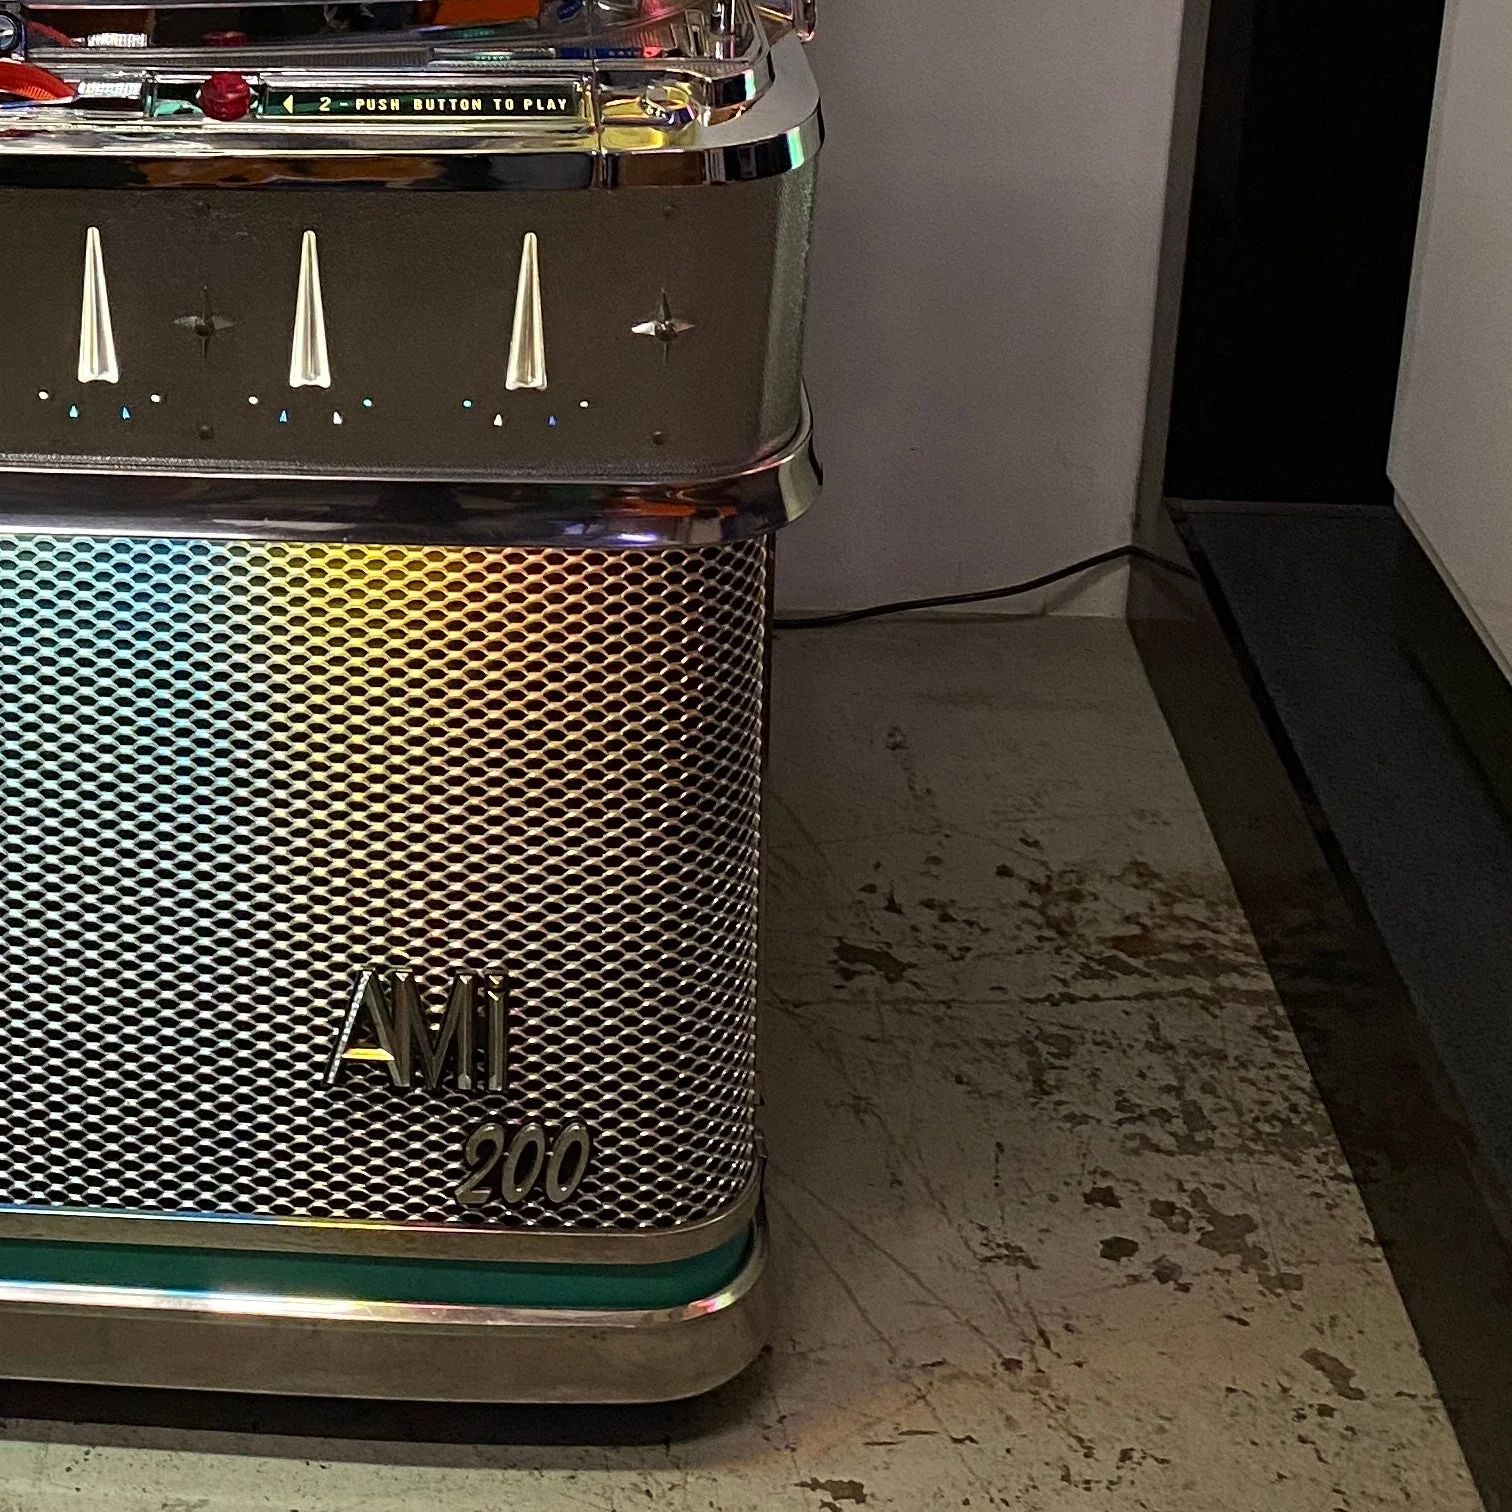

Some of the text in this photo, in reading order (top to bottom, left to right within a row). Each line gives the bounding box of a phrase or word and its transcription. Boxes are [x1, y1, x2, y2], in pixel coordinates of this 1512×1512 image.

[319, 97, 331, 111] 2
[355, 98, 400, 111] PUSH
[413, 98, 482, 111] BUTTON
[493, 98, 513, 111] TO
[523, 98, 567, 111] PLAY
[454, 1116, 593, 1205] 200
